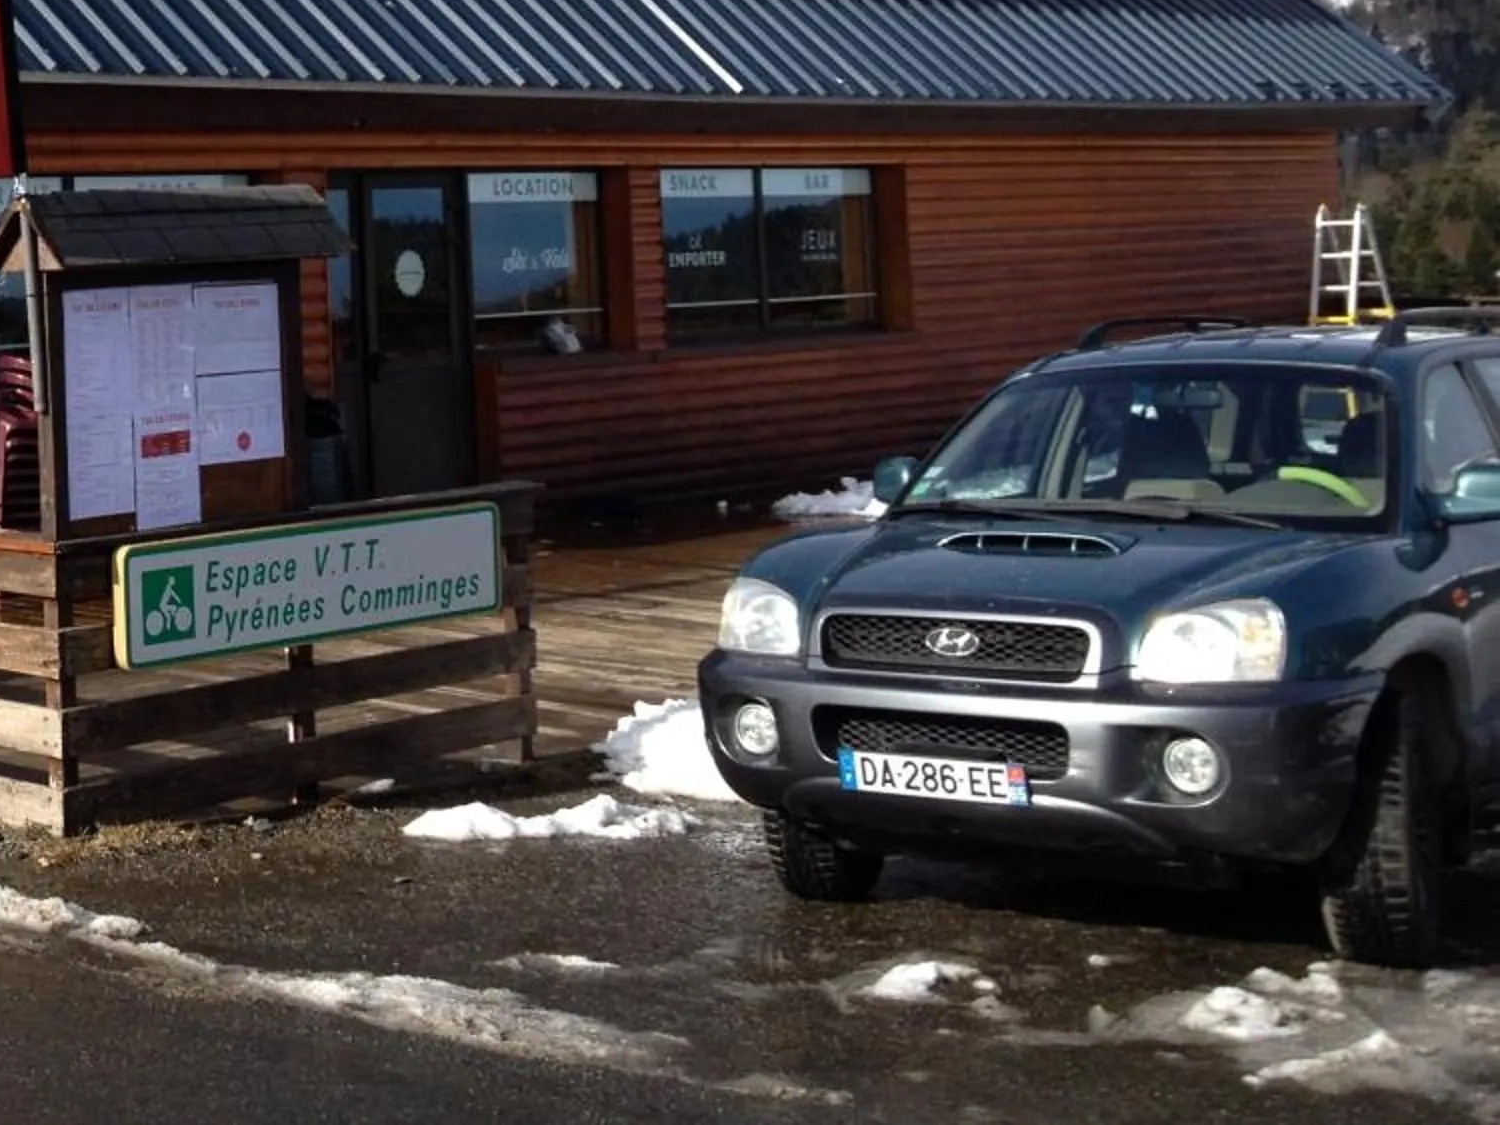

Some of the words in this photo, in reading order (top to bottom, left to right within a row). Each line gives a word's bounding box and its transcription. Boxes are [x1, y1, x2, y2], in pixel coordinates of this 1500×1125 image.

[493, 178, 574, 196] LOCATION
[669, 174, 718, 192] SNACK
[205, 557, 297, 598] Espace
[315, 538, 386, 576] V.T.T.
[207, 593, 325, 642] Pyrénées
[341, 572, 480, 613] Comminges
